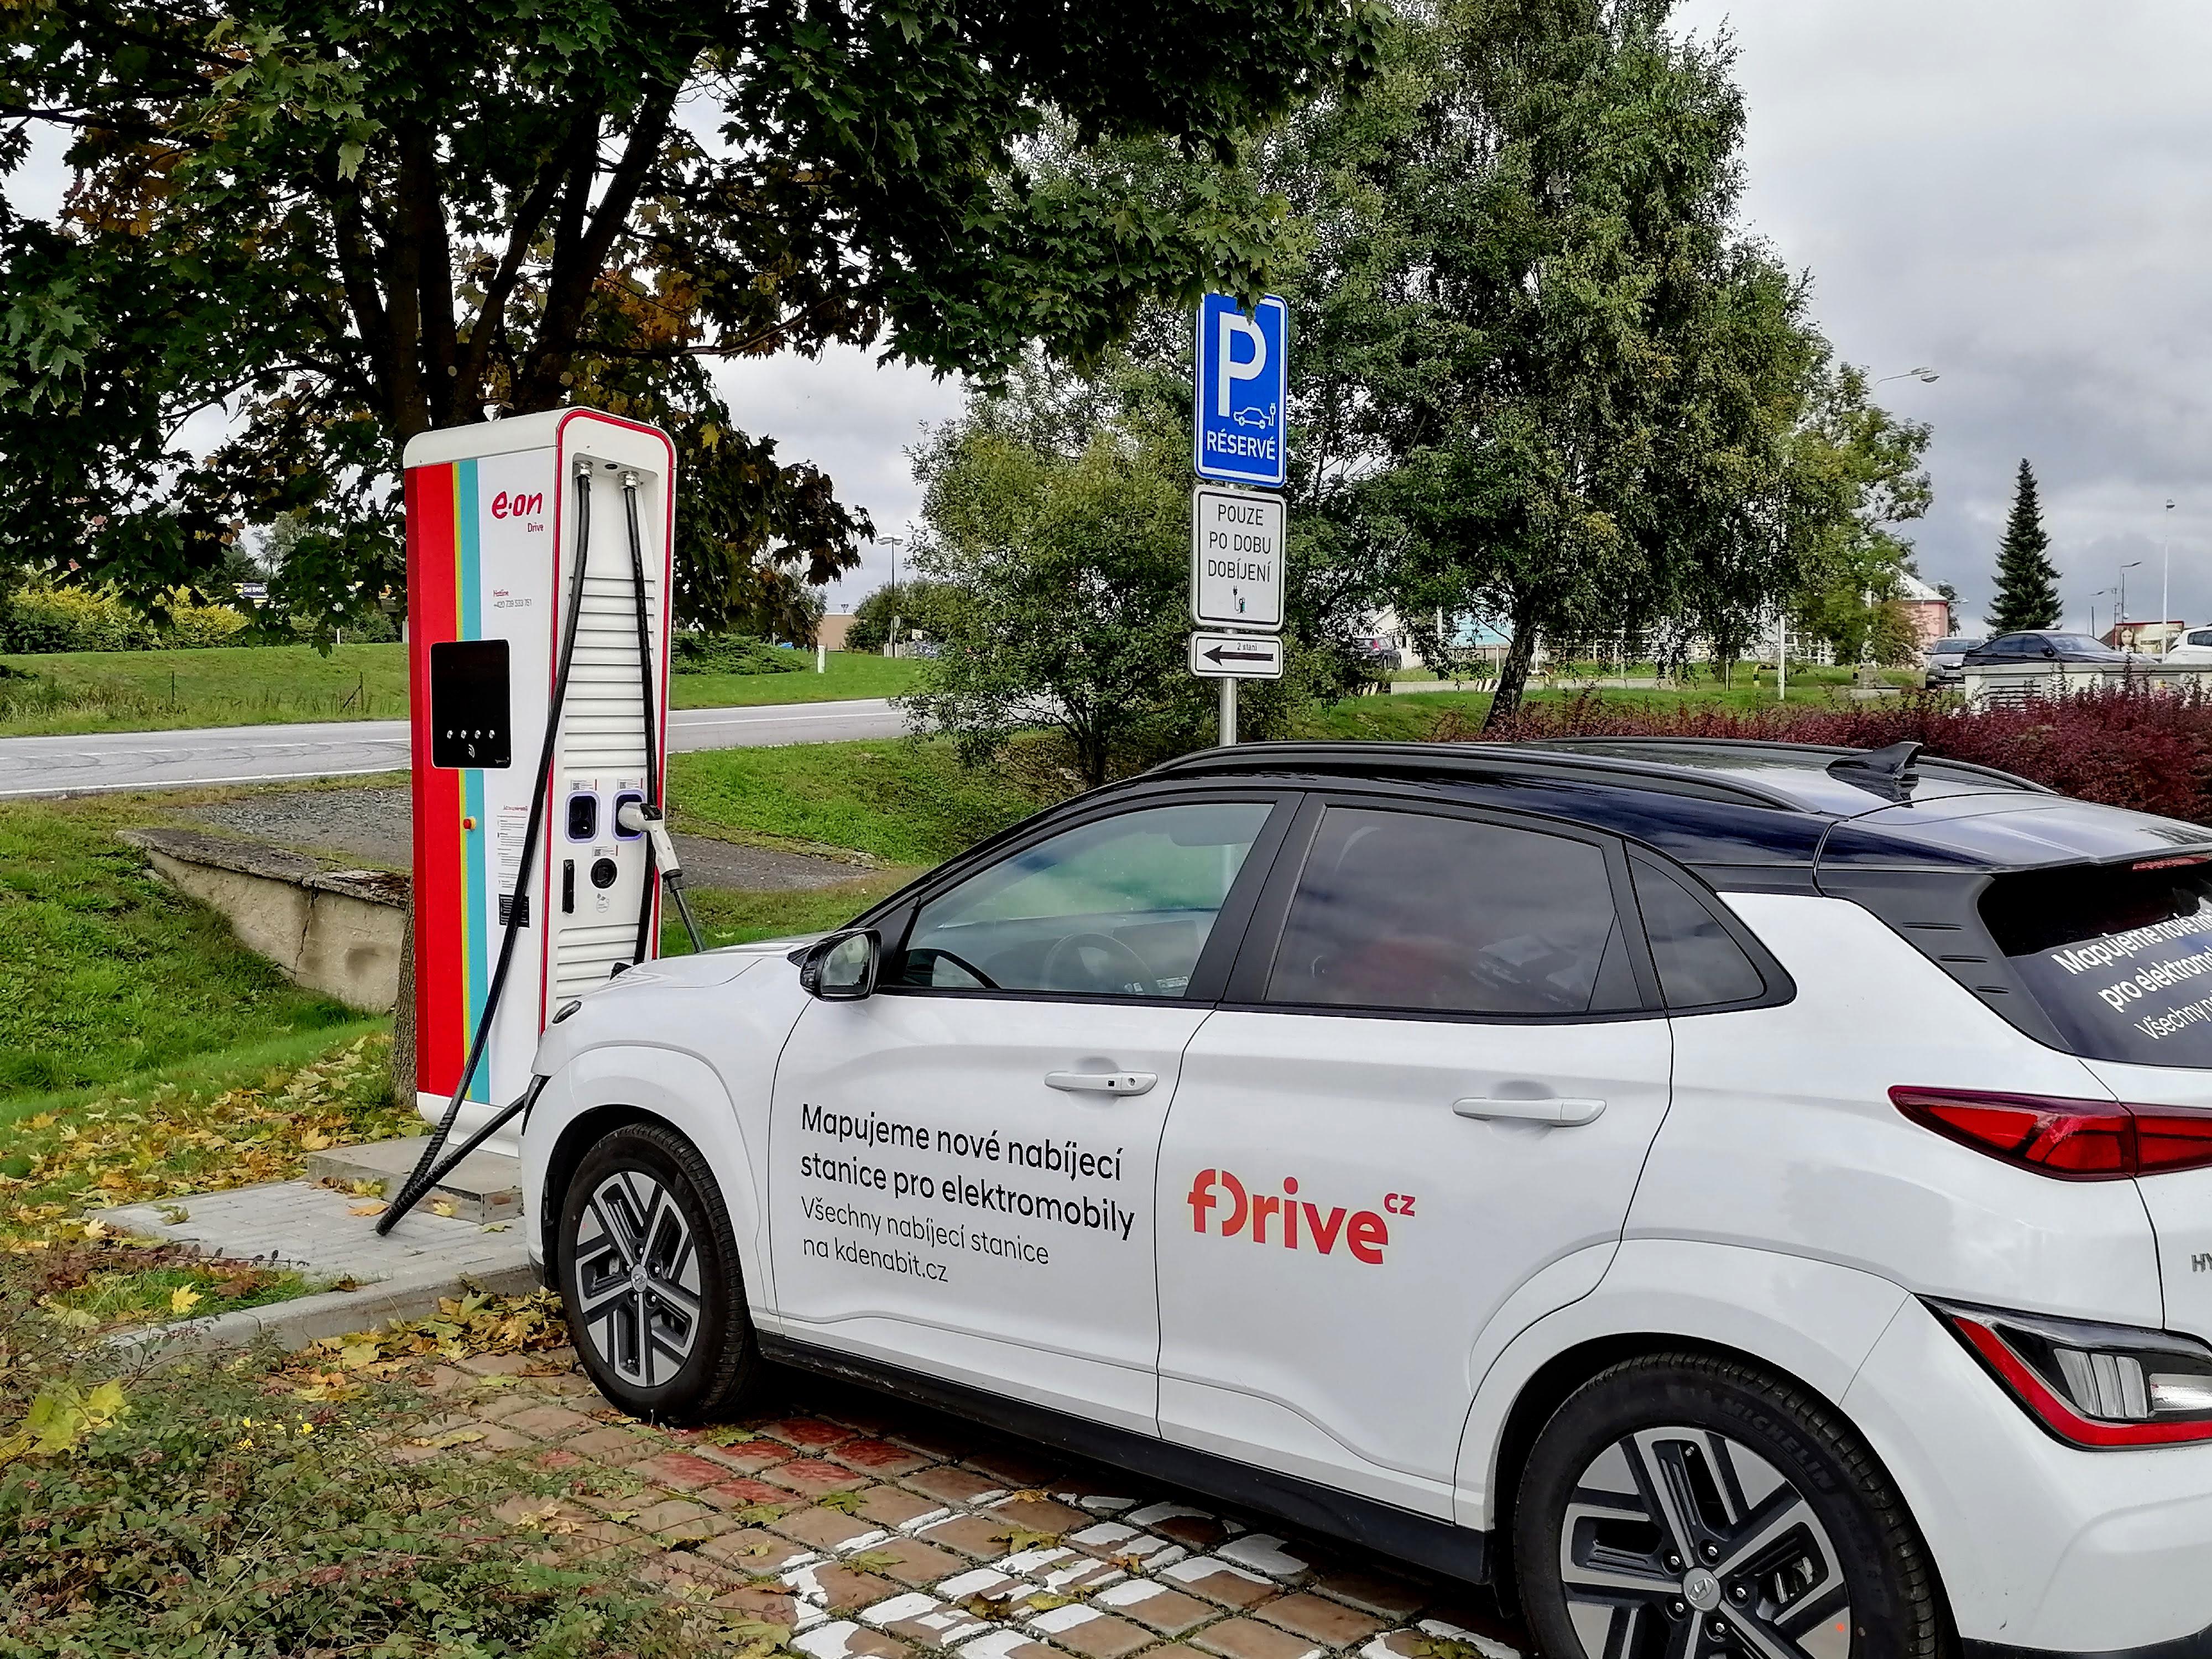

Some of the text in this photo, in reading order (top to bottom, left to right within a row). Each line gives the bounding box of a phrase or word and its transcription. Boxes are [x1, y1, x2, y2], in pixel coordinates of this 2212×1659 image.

[1218, 311, 1267, 418] P
[1207, 428, 1276, 461] RÉSERVÉ
[528, 522, 544, 533] Drive
[1218, 503, 1264, 526] POUZE
[1209, 531, 1271, 554] PO DOBU
[1208, 557, 1271, 583] DOBÍJENÍ
[1237, 642, 1241, 651] 2
[2051, 927, 2163, 975] Mapujeme
[2152, 912, 2199, 939] nové
[2098, 981, 2142, 1013] pro
[2133, 1003, 2211, 1039] Všechny
[802, 1103, 1124, 1182] Mapujeme nové nabíjecí
[801, 1152, 1135, 1241] stanice pro elektromobily
[801, 1196, 1048, 1265] Všechny nabíjecí stanice
[804, 1237, 948, 1282] na kdenabit.cz
